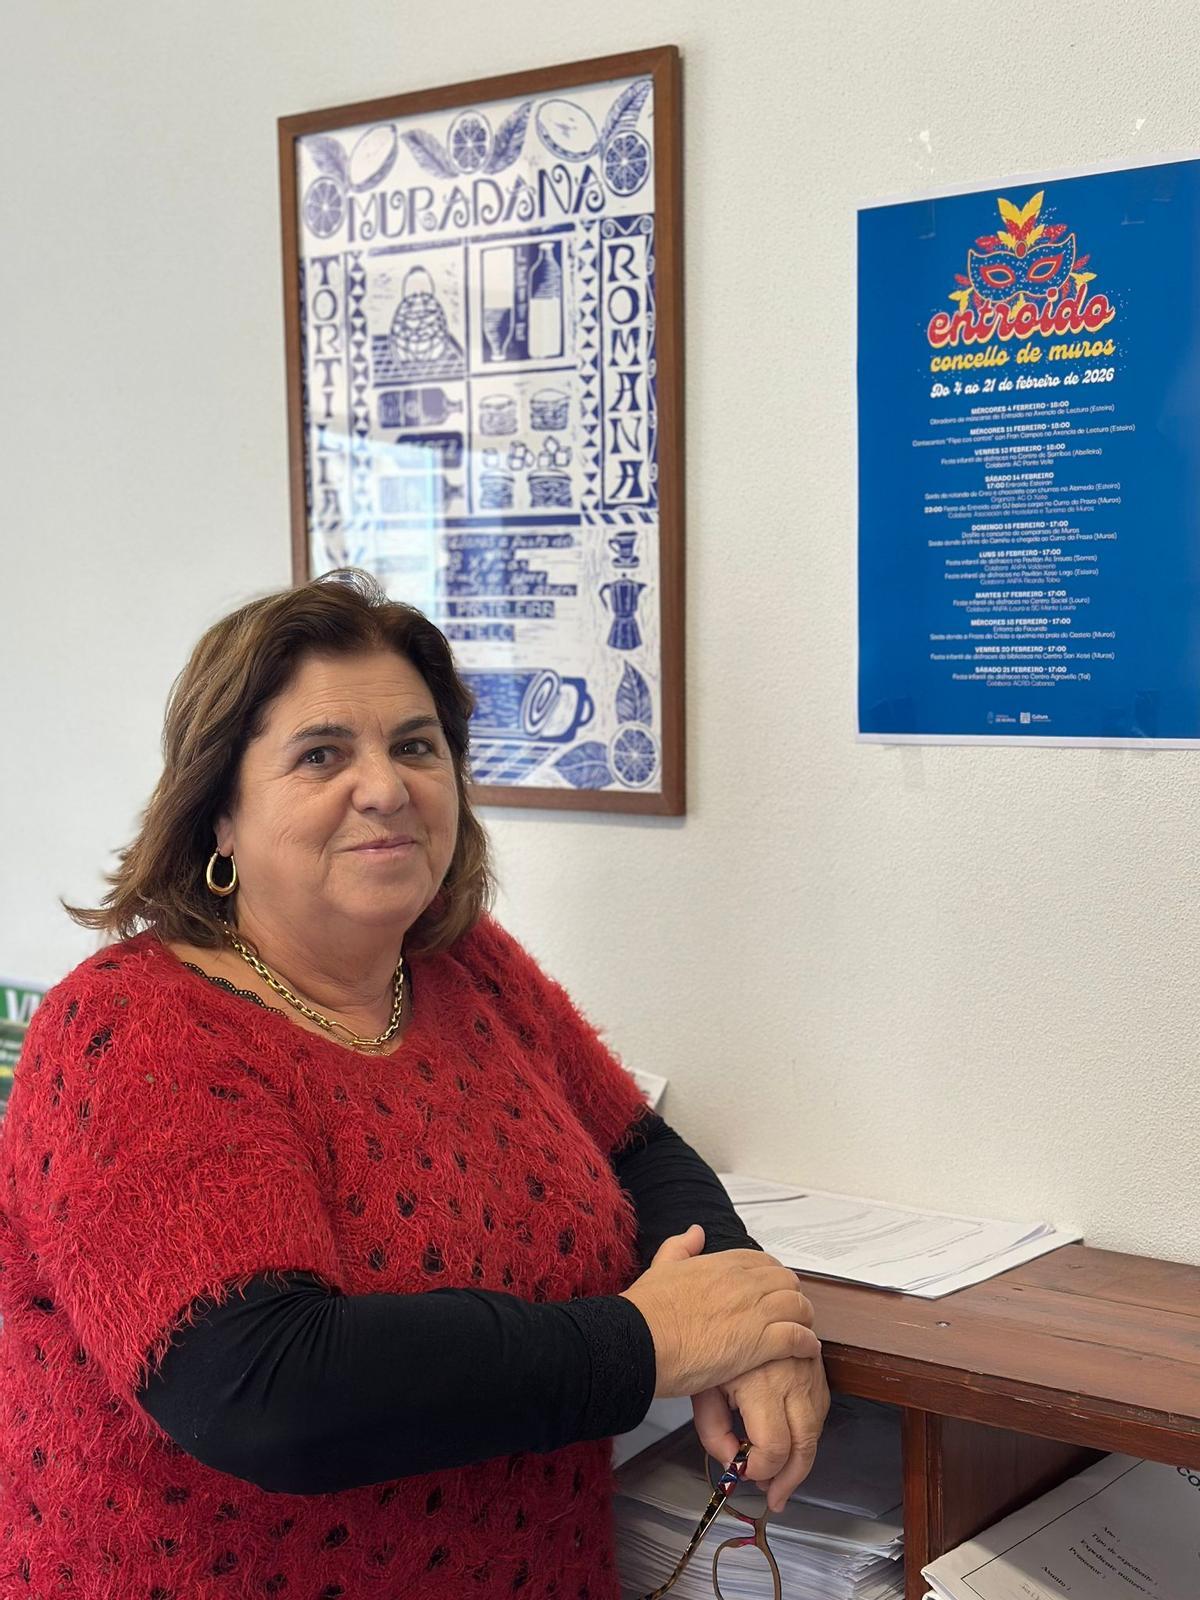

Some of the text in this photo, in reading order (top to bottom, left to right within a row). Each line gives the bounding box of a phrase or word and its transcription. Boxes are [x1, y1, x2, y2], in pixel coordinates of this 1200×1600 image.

[347, 164, 606, 242] MURADANA
[927, 284, 1116, 348] entroido
[930, 339, 1117, 372] concello de muros
[607, 243, 643, 499] ROMANA
[930, 368, 1115, 398] Do 4 ao 21 de febreiro de 2026
[1013, 403, 1045, 411] FEBREIRO
[1014, 423, 1046, 432] FEBREIRO
[1009, 445, 1042, 454] FEBREIRO
[1021, 472, 1054, 481] FEBREIRO
[1012, 521, 1045, 529] FEBREIRO
[1006, 549, 1038, 557] FEBREIRO
[1177, 1466, 1200, 1492] CO
